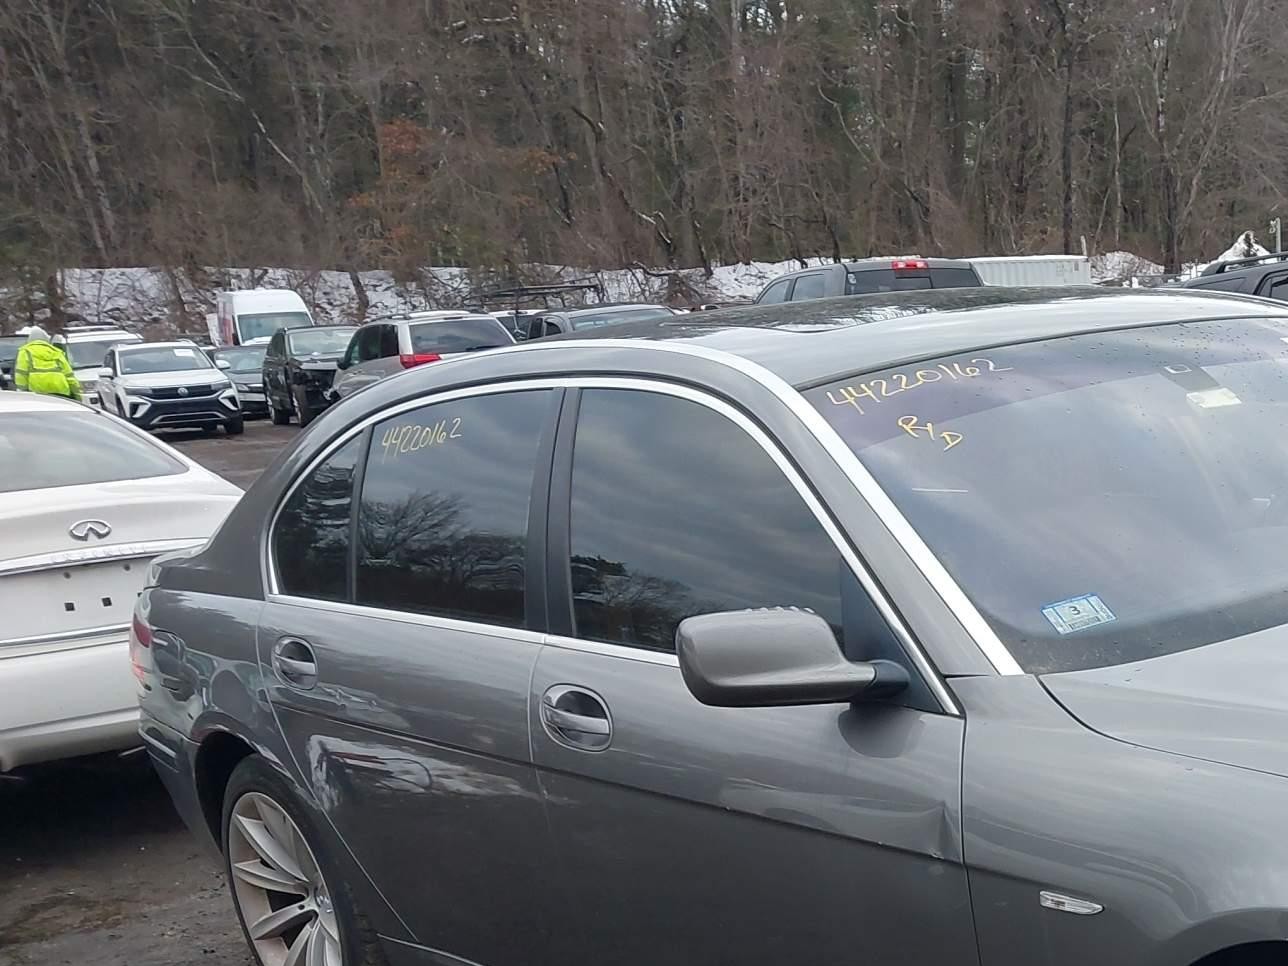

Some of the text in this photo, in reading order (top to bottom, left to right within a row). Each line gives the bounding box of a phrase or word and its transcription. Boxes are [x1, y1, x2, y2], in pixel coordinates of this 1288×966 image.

[827, 358, 1015, 415] 44220162
[381, 417, 463, 460] 44220162
[1069, 606, 1081, 616] 3
